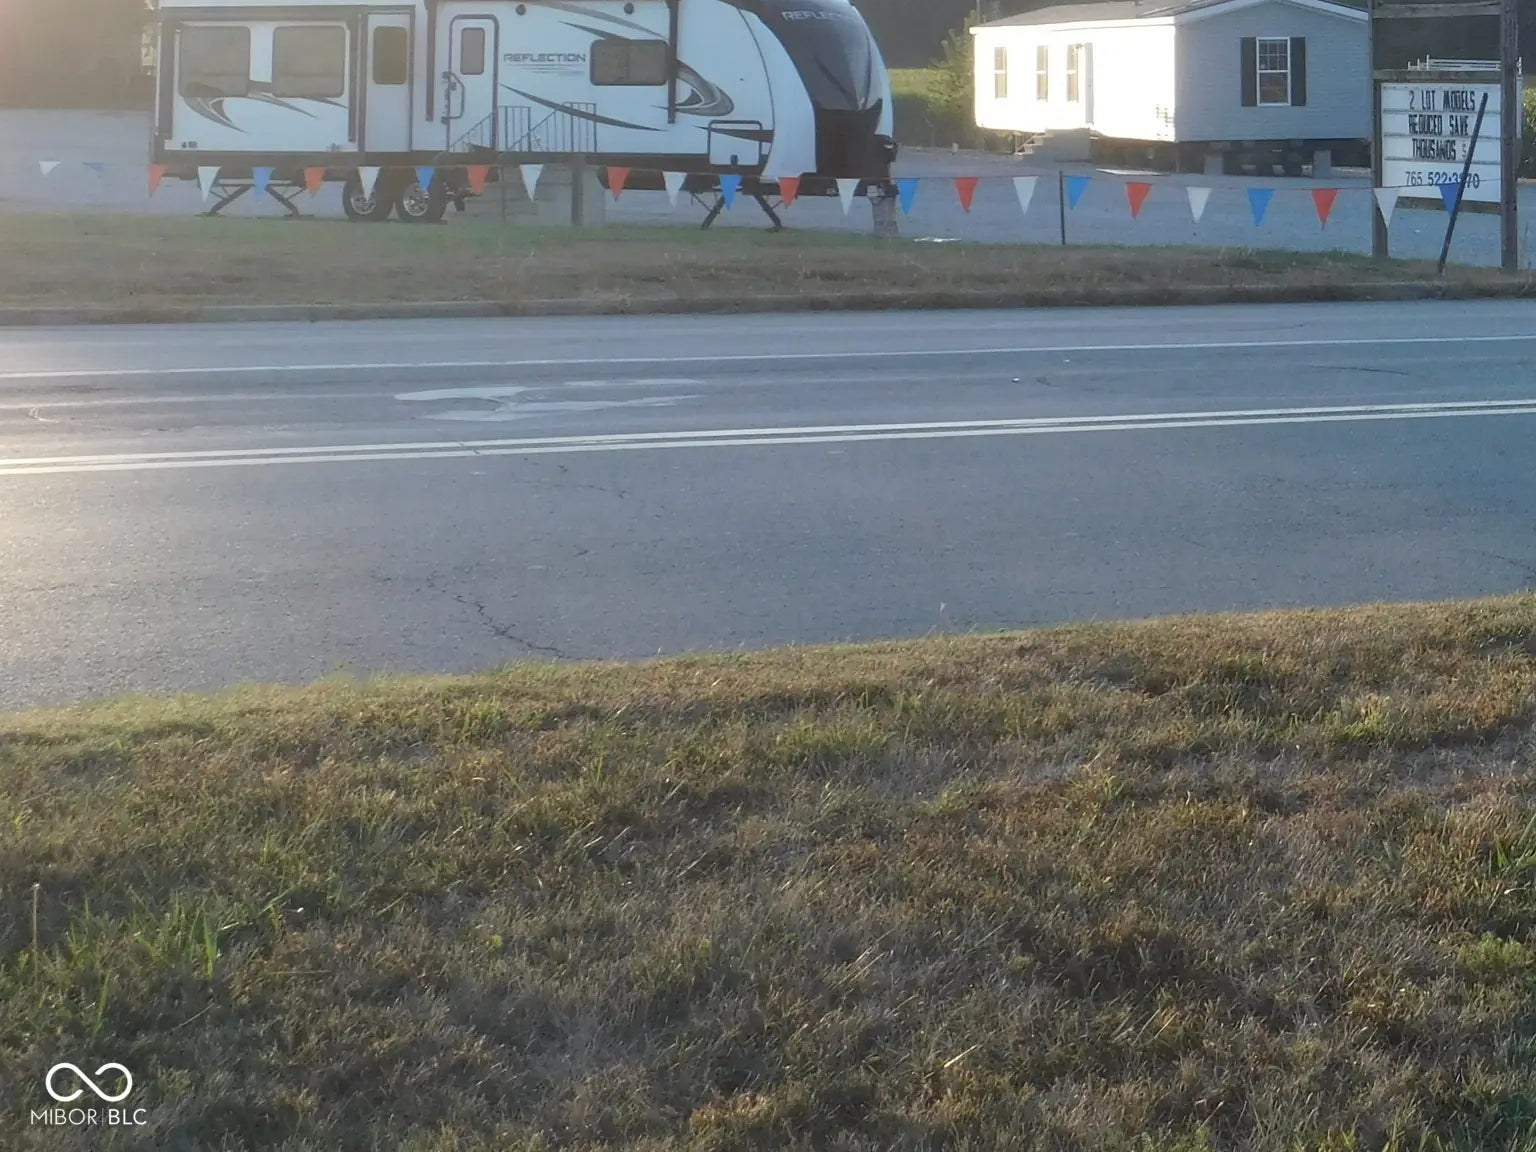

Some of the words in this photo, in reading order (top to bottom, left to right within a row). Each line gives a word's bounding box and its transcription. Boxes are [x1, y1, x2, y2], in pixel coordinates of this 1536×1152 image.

[503, 53, 586, 62] REFLECTION
[1408, 90, 1415, 110] 2
[1421, 90, 1436, 110] LOT
[1443, 90, 1476, 111] MODELS
[1408, 114, 1443, 136] REDUCED
[1449, 115, 1469, 136] SAVE
[1412, 138, 1456, 160] THOUSANDS
[1405, 171, 1423, 186] 765
